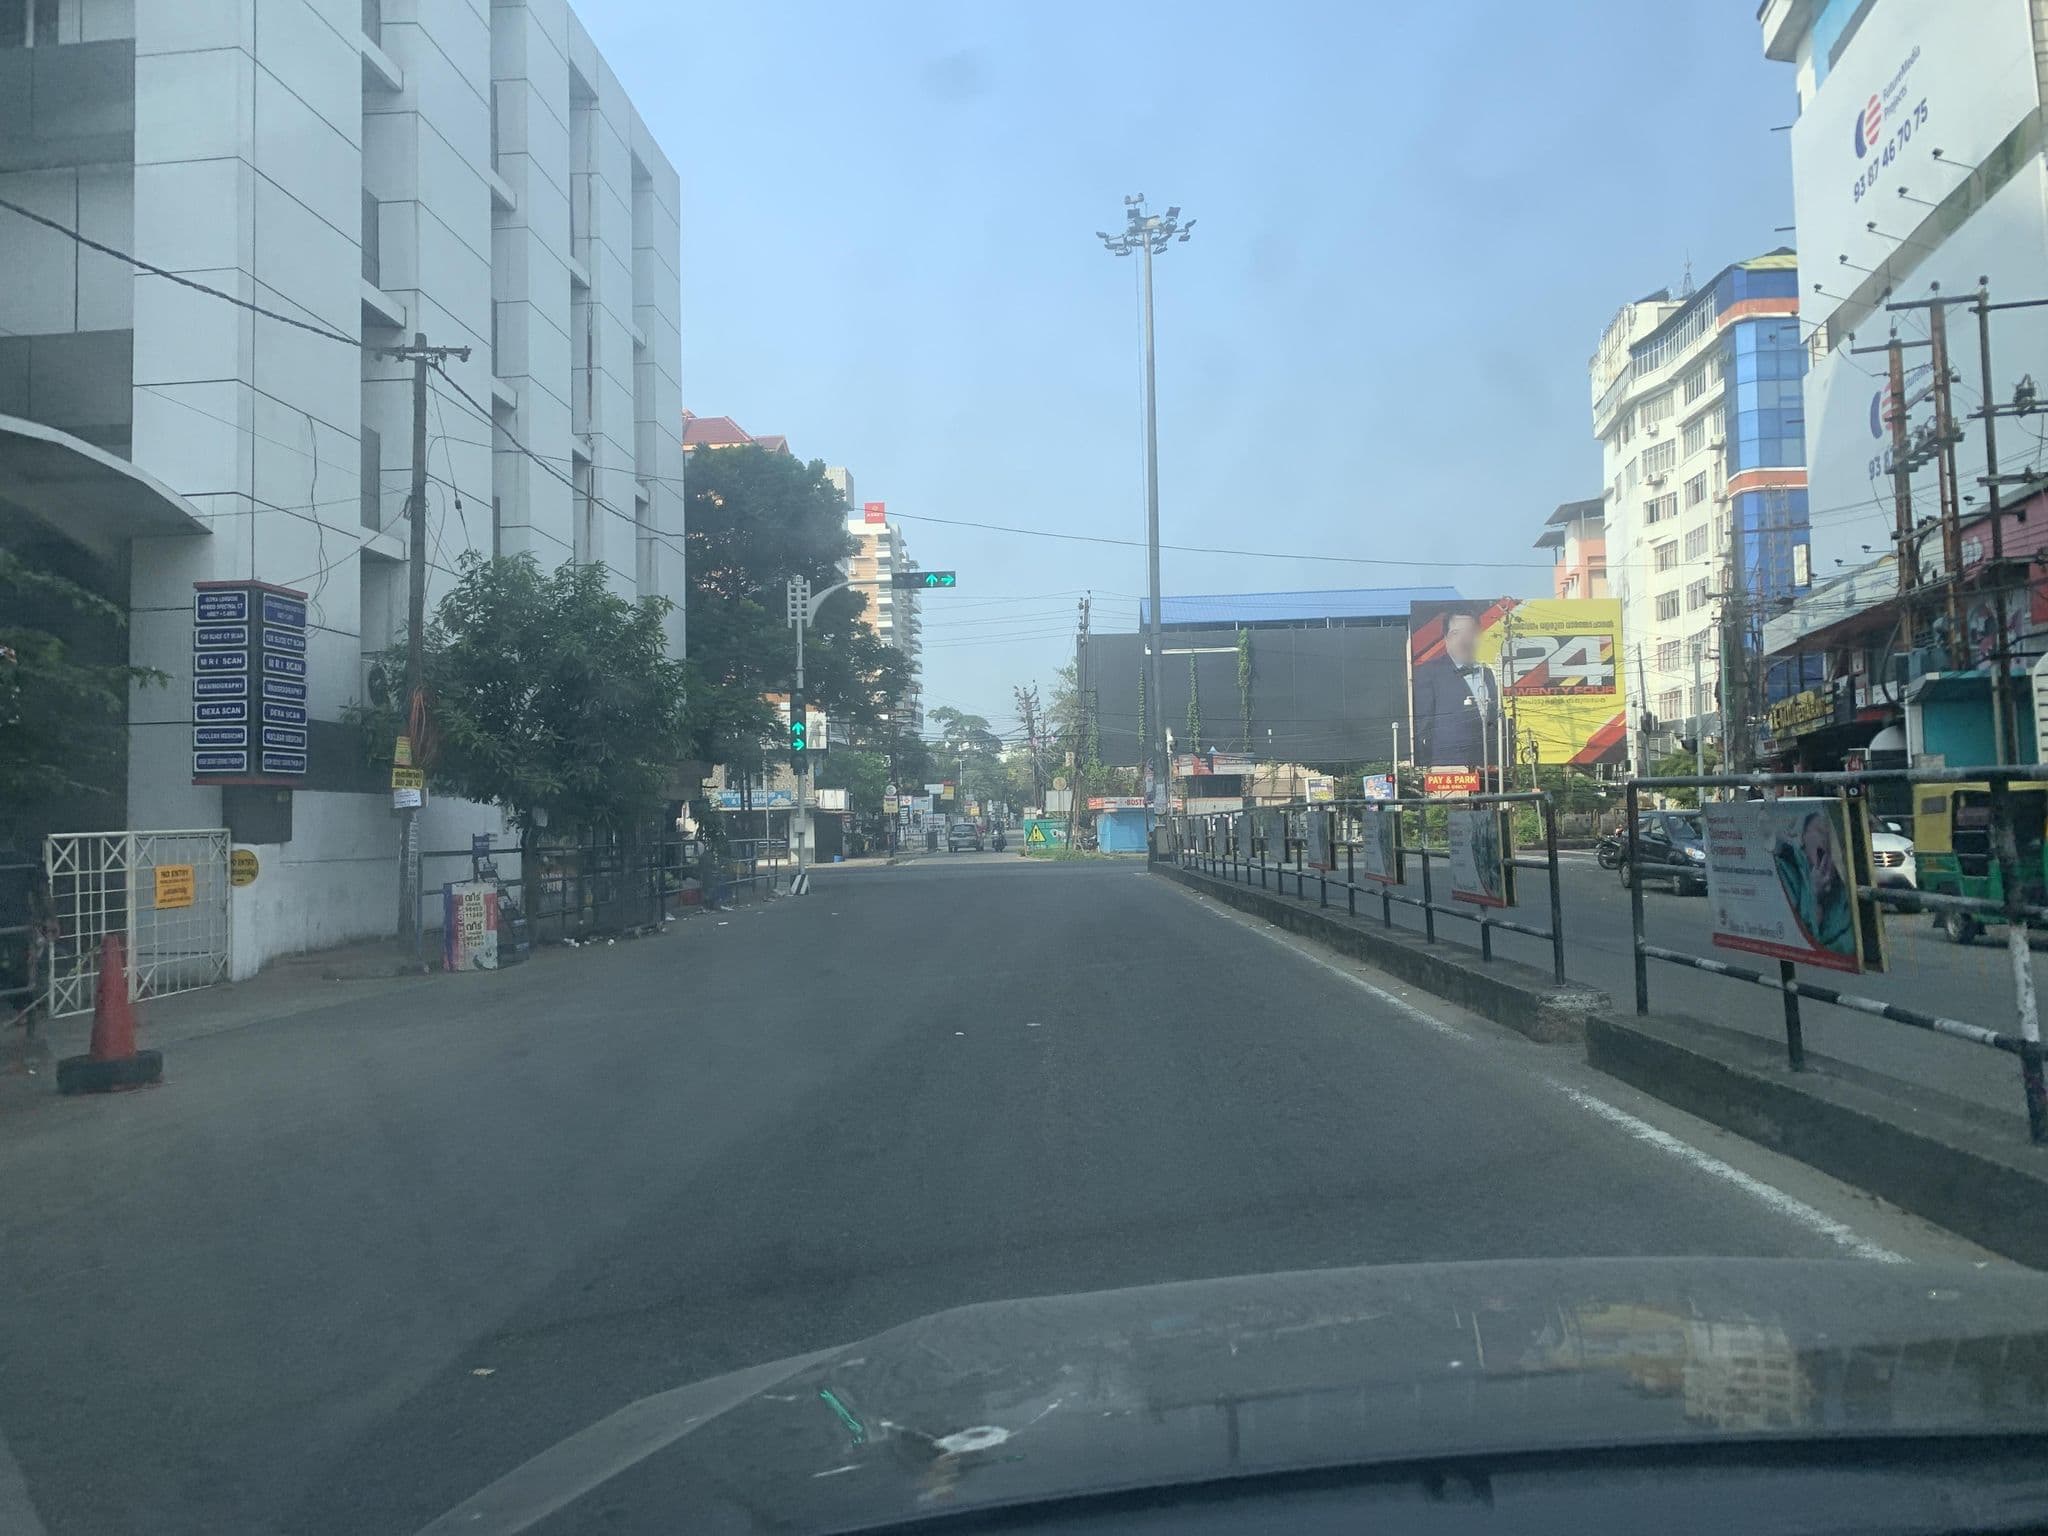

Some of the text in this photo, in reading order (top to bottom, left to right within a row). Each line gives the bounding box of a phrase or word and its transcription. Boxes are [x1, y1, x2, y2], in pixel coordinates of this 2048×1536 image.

[1854, 97, 1928, 203] 93 87 46 70 75
[222, 657, 242, 665] SCAN
[1503, 635, 1614, 688] 24
[286, 661, 302, 672] SCAN
[1503, 685, 1616, 696] TWENTY FOUR
[201, 706, 242, 716] DEXA SCAN
[285, 710, 301, 719] SCAN
[1427, 775, 1477, 784] PAY & PARK
[171, 869, 189, 878] ENTRY
